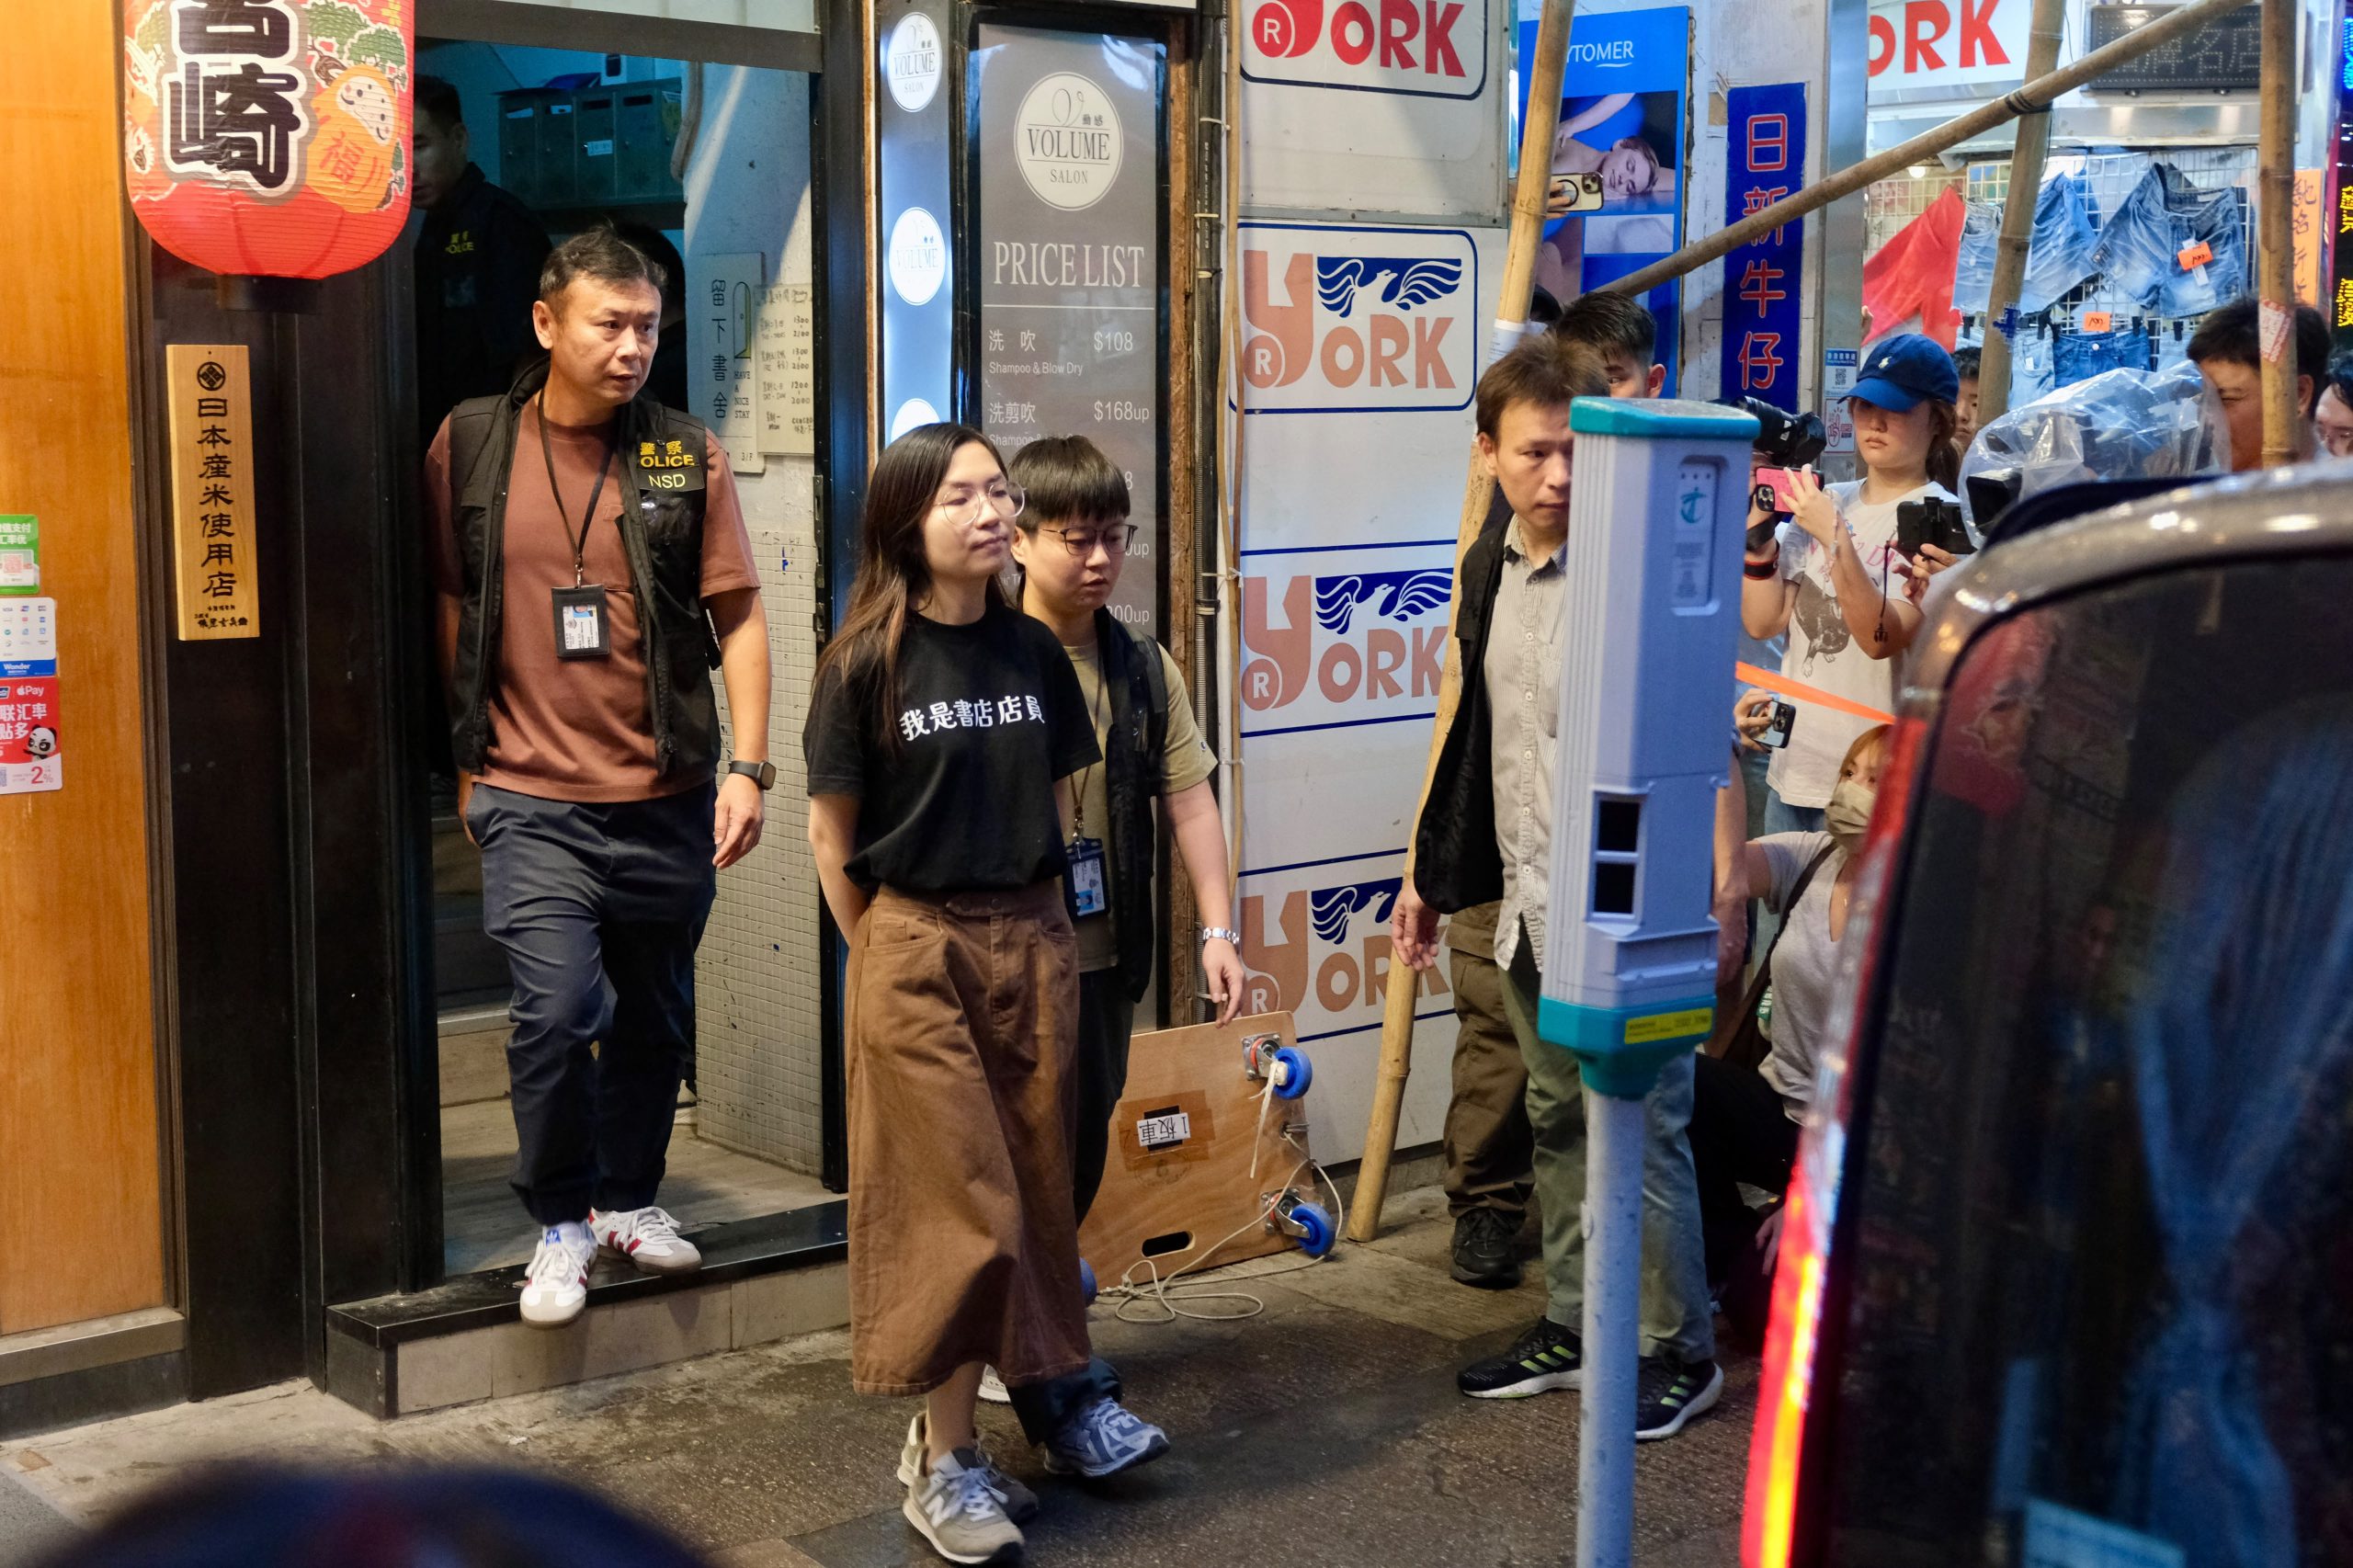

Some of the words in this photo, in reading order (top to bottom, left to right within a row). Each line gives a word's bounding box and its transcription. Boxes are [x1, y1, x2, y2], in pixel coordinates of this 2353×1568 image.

[894, 52, 936, 75] VOLUME
[1028, 129, 1110, 161] VOLUME
[1051, 169, 1088, 184] SALON
[1739, 113, 1788, 390] 日新牛仔
[994, 242, 1077, 287] PRICE
[1084, 245, 1145, 288] LIST
[1094, 331, 1133, 353] $108
[734, 371, 750, 380] HAVE
[989, 361, 1031, 376] Shampoo
[1032, 362, 1041, 374] &
[1042, 362, 1065, 374] Blow
[1066, 362, 1083, 377] Dry
[734, 410, 750, 418] STAY
[989, 402, 1036, 424] 洗剪吹
[1094, 400, 1149, 424] $168up
[641, 440, 682, 455] 警察
[649, 474, 686, 488] NSD
[197, 397, 236, 597] 日本産米使用店
[26, 686, 44, 697] Pay
[899, 695, 1046, 742] 我是書店店員
